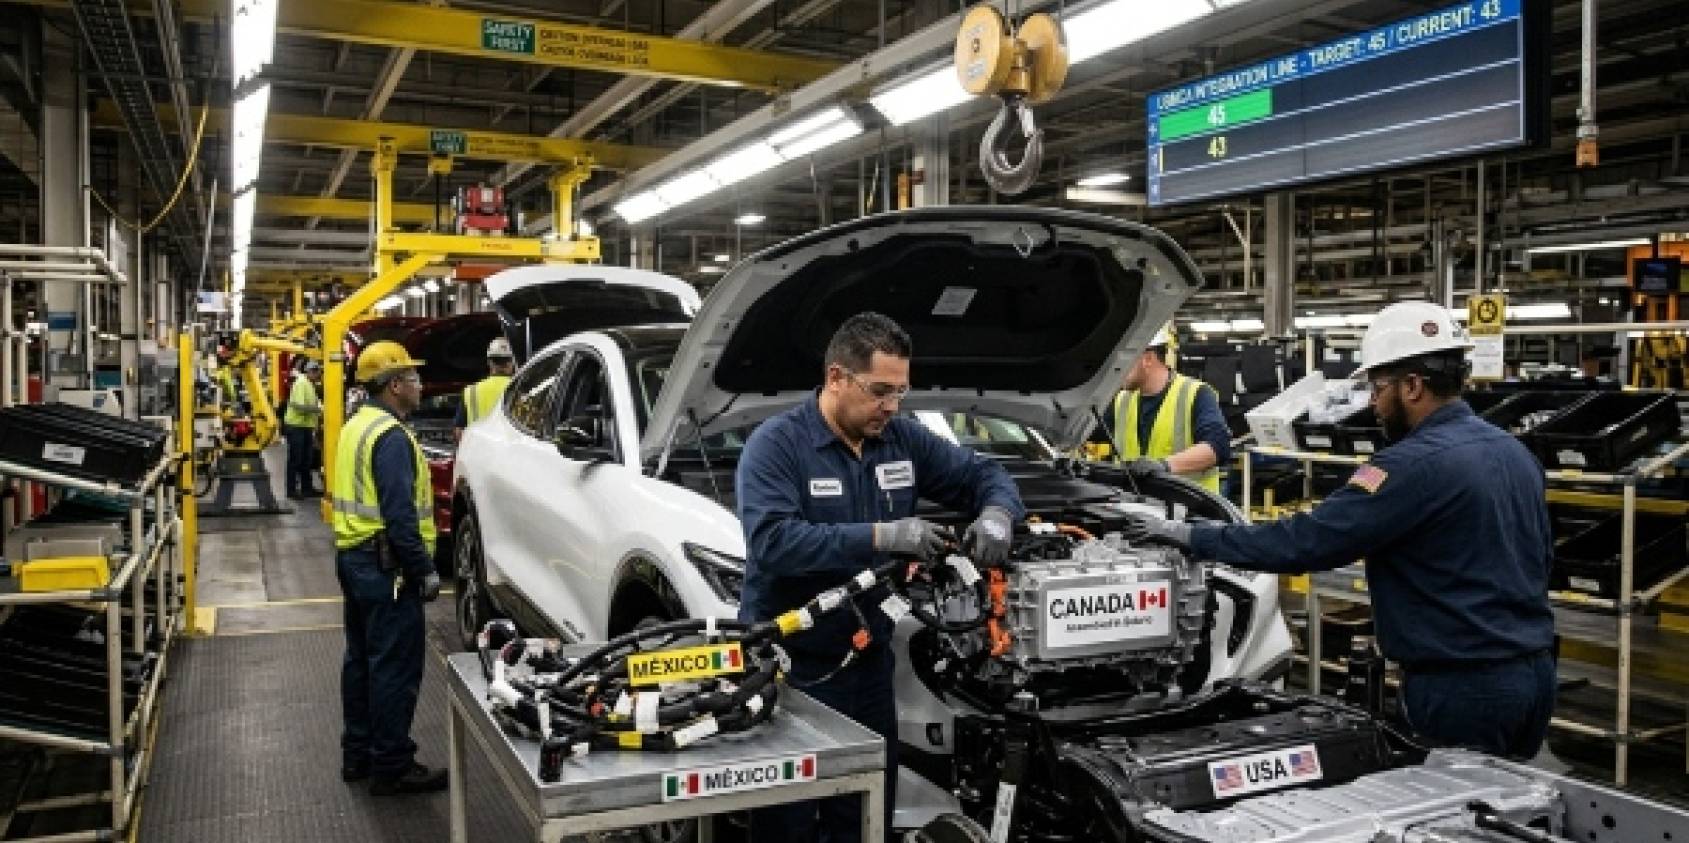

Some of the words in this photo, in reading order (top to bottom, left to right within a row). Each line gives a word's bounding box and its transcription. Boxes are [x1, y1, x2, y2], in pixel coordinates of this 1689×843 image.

[1309, 38, 1366, 67] TARGET:
[1368, 33, 1386, 50] 45
[1396, 6, 1476, 42] CURRENT:
[1480, 0, 1500, 18] 43
[1207, 103, 1226, 126] 45
[1207, 136, 1226, 158] 43
[1049, 592, 1135, 619] CANADA
[632, 654, 710, 679] MÉXICO
[704, 764, 778, 790] MÉXICO
[1244, 756, 1288, 784] USA
